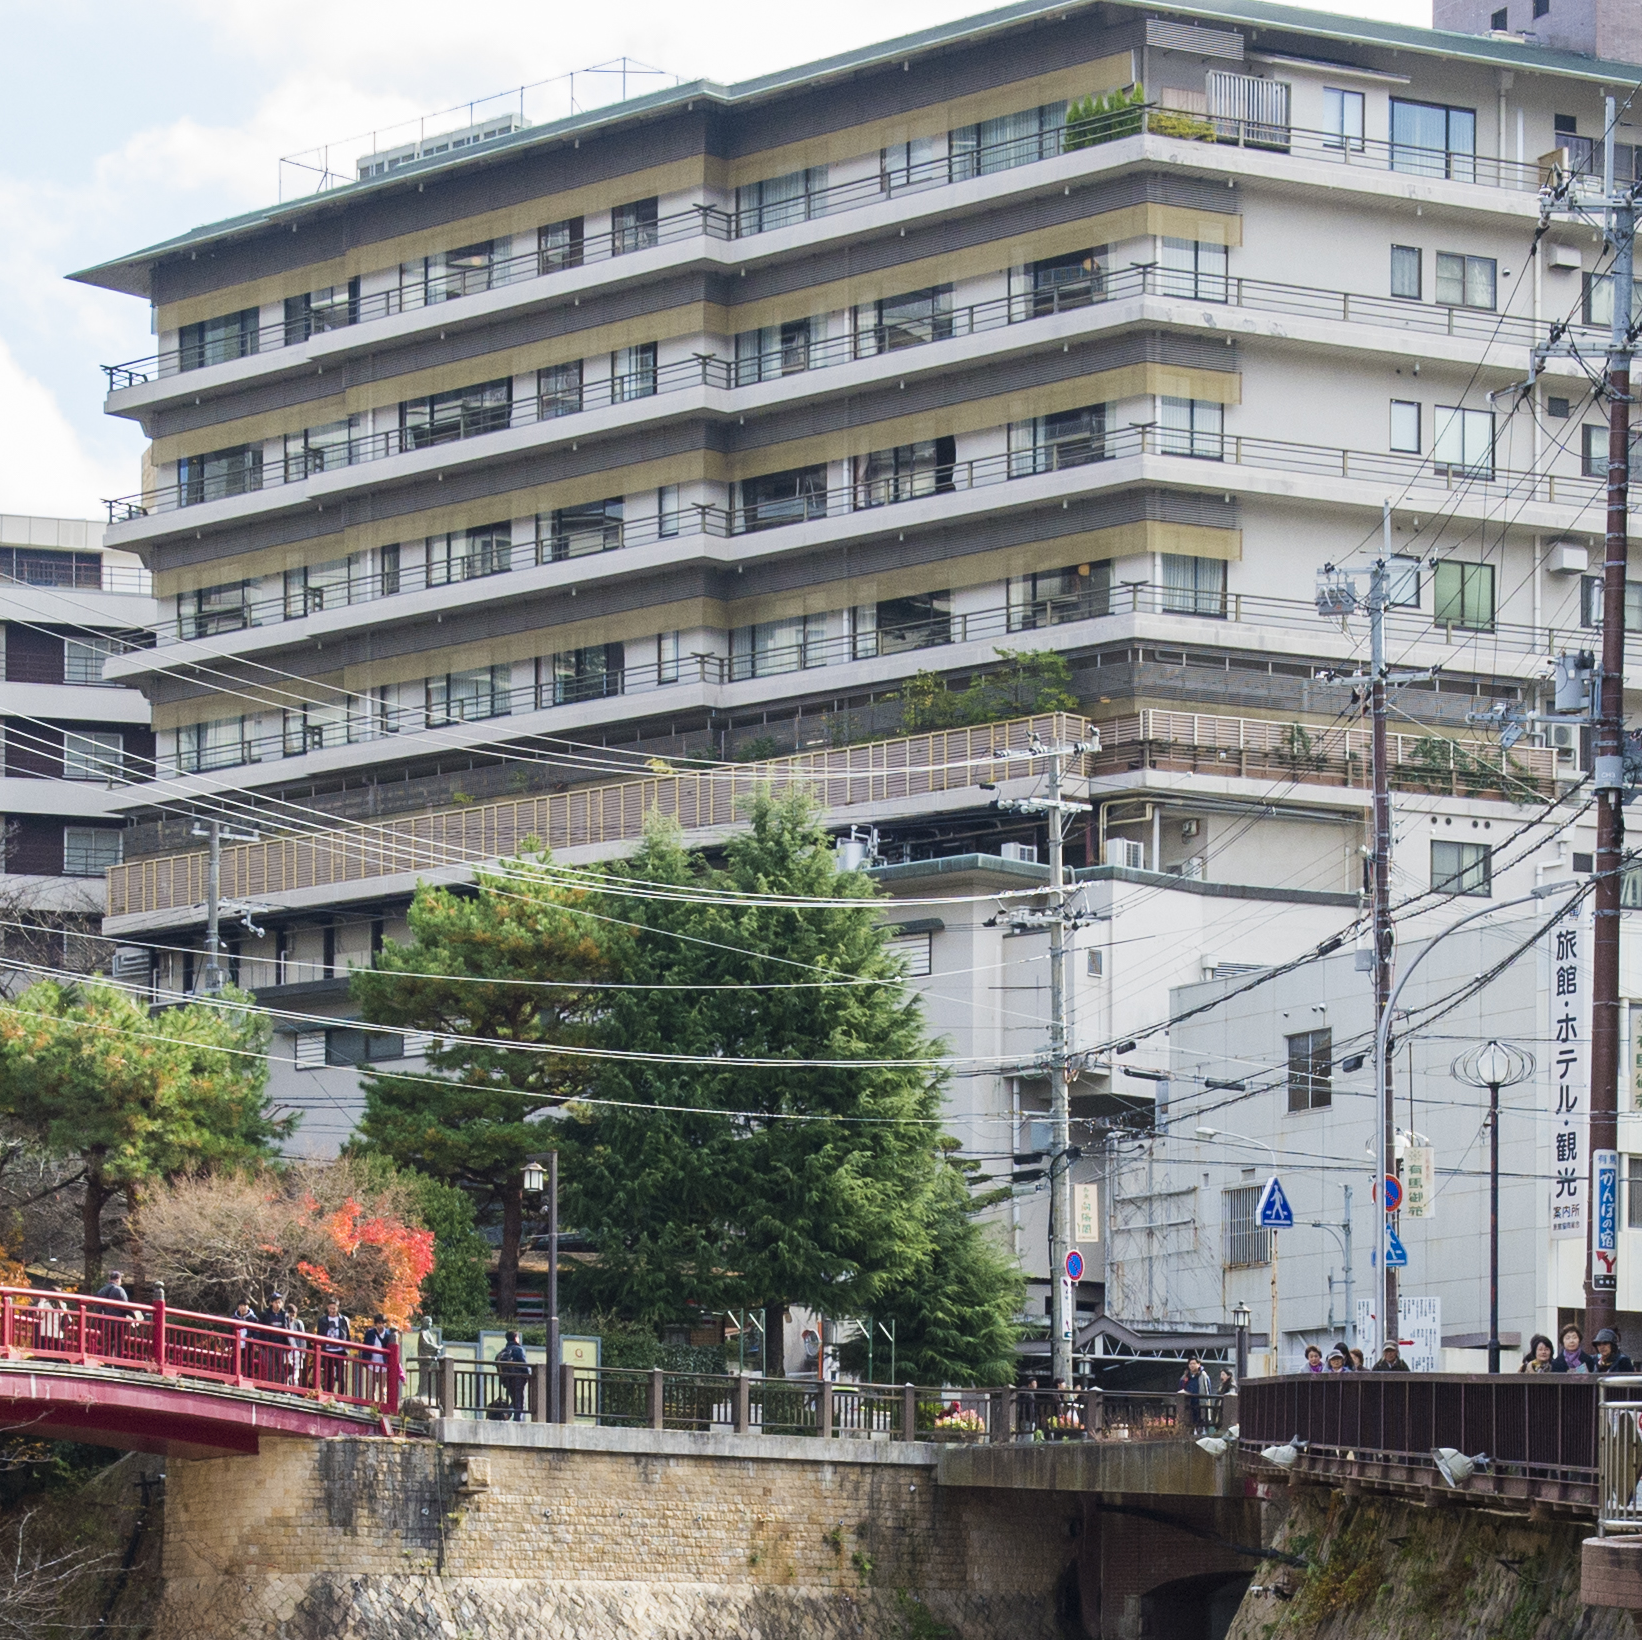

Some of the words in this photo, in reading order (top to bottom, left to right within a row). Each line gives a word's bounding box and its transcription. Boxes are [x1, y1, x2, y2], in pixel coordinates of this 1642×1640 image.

[1555, 929, 1578, 1199] 旅館・ホテル・観光
[1598, 1154, 1617, 1165] 有馬
[1553, 1203, 1580, 1219] 案内所
